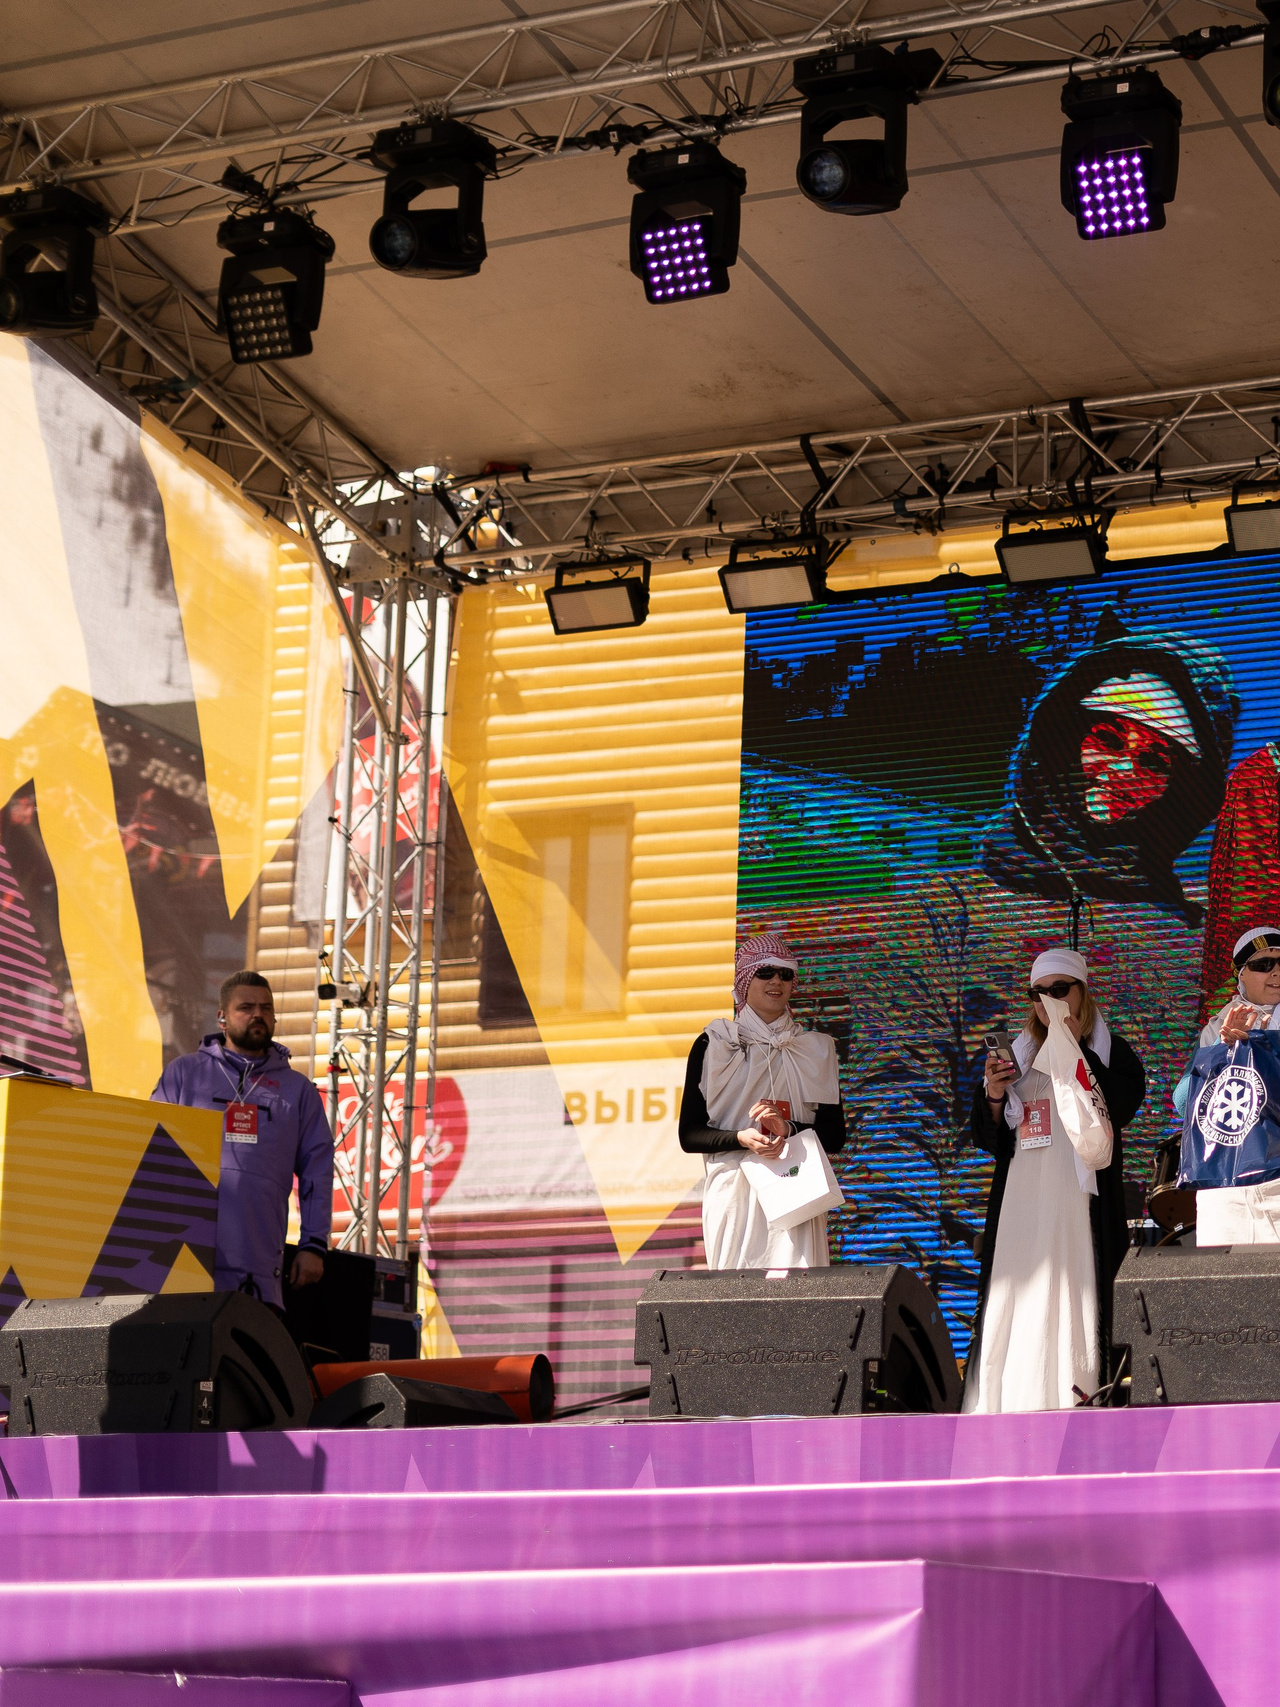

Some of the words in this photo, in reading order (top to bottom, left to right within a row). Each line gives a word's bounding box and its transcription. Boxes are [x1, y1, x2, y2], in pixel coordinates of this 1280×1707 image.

[674, 1346, 840, 1367] ProTone
[30, 1368, 172, 1390] ProTone
[202, 1396, 208, 1409] 4
